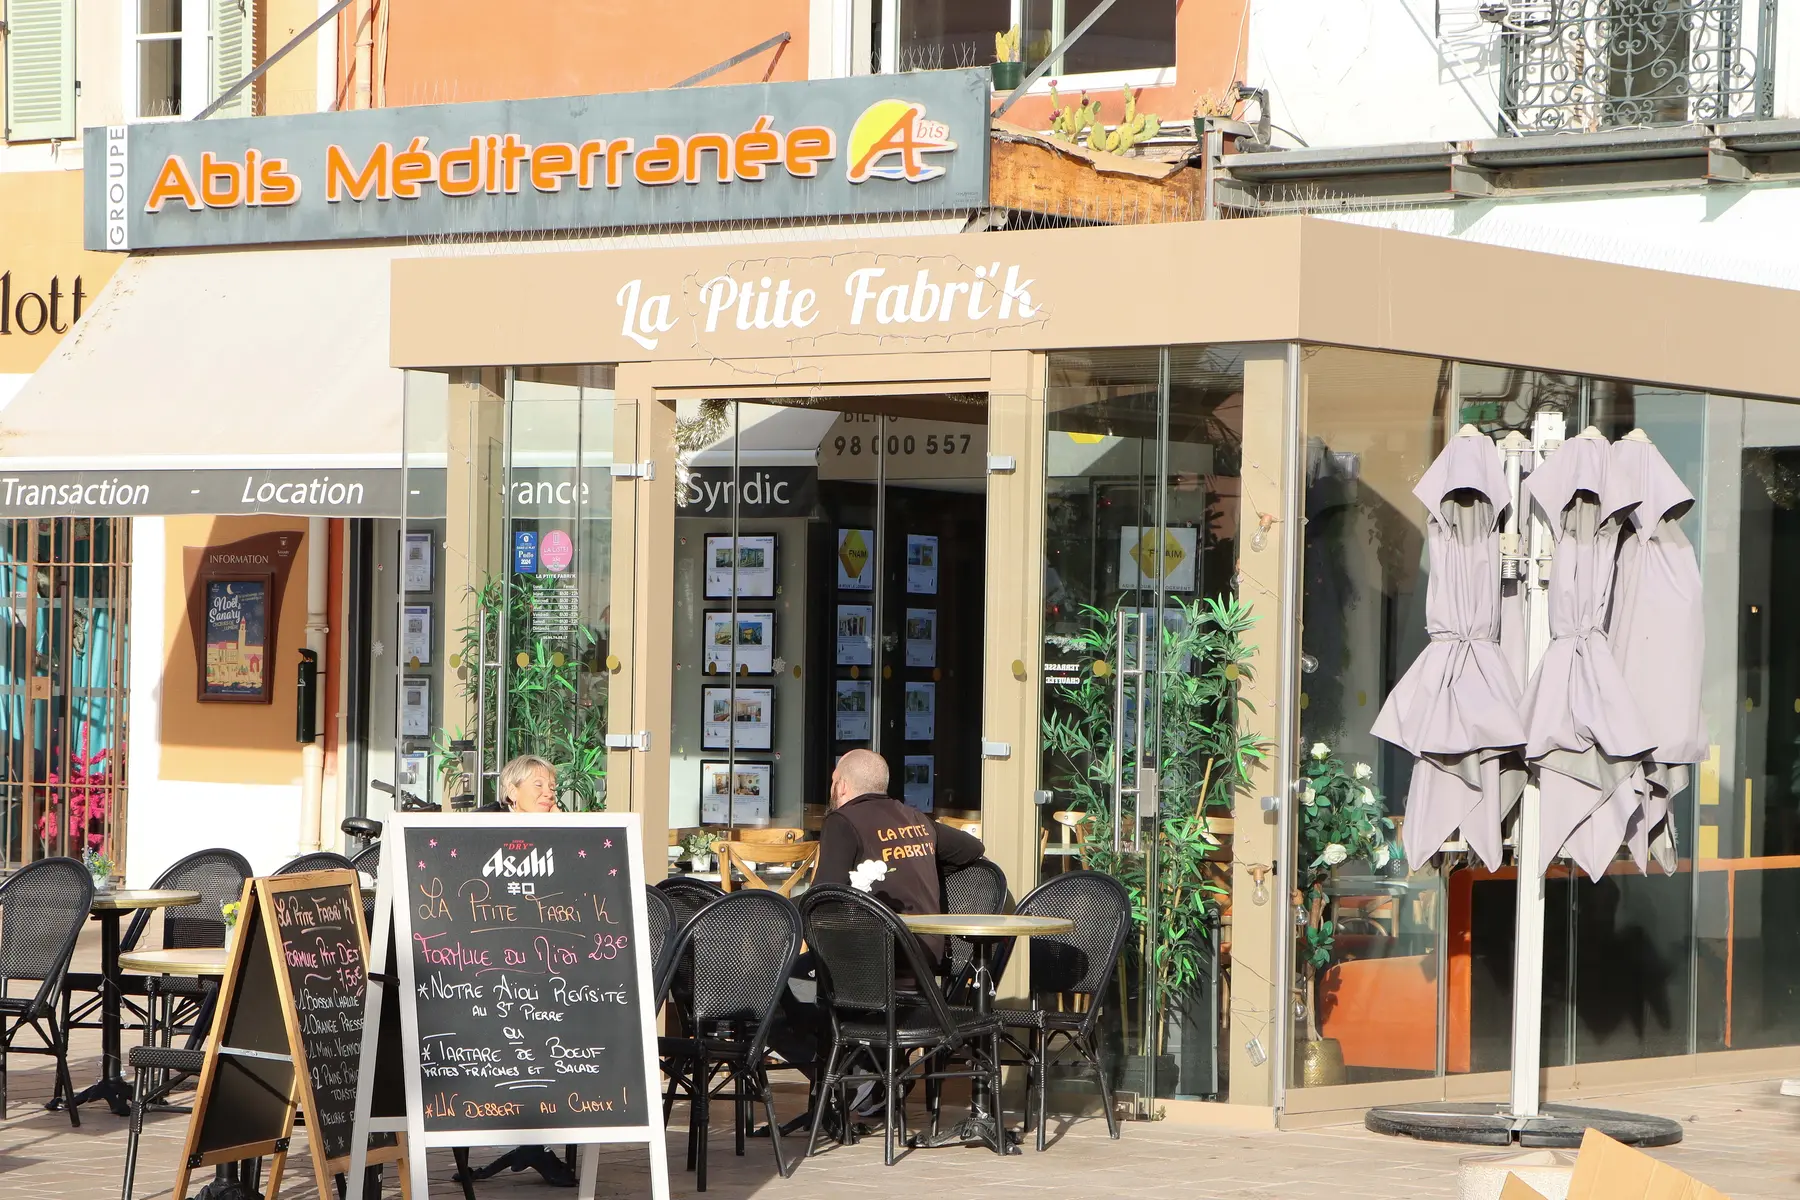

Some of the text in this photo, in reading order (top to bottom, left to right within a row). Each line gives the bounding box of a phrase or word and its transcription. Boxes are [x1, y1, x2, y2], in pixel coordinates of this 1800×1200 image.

[145, 113, 838, 212] Abis Méditerranée
[109, 127, 125, 246] GROUPE
[616, 261, 1043, 351] La Ptite Fabri'k
[834, 435, 862, 456] 98
[926, 434, 972, 455] 557
[2, 477, 150, 507] Transaction
[241, 476, 364, 505] Location
[687, 472, 791, 513] Syndic
[209, 554, 269, 565] INFORMATION
[1149, 550, 1183, 558] FAIM
[209, 607, 242, 624] Sanary
[877, 824, 930, 842] LA PTITE
[482, 847, 554, 878] Asahi
[418, 877, 453, 921] LA
[507, 882, 535, 895] 辛口
[274, 897, 292, 927] LA
[283, 940, 319, 969] FORMULE
[413, 932, 493, 971] FORMULE
[303, 988, 333, 1011] BOISSON
[431, 971, 484, 1000] NOTRE
[549, 977, 628, 1006] REVISITÉ
[309, 1013, 339, 1035] ORANGE
[472, 1005, 487, 1017] AU
[519, 1003, 564, 1022] PIERRE
[430, 1033, 502, 1062] TARTARE
[514, 1049, 536, 1061] DE
[321, 1064, 343, 1085] PAINS
[528, 1067, 545, 1075] ET
[555, 1061, 600, 1074] SALADE
[463, 1100, 525, 1118] DESSERT
[540, 1102, 557, 1113] AU
[568, 1092, 613, 1112] CHOIX
